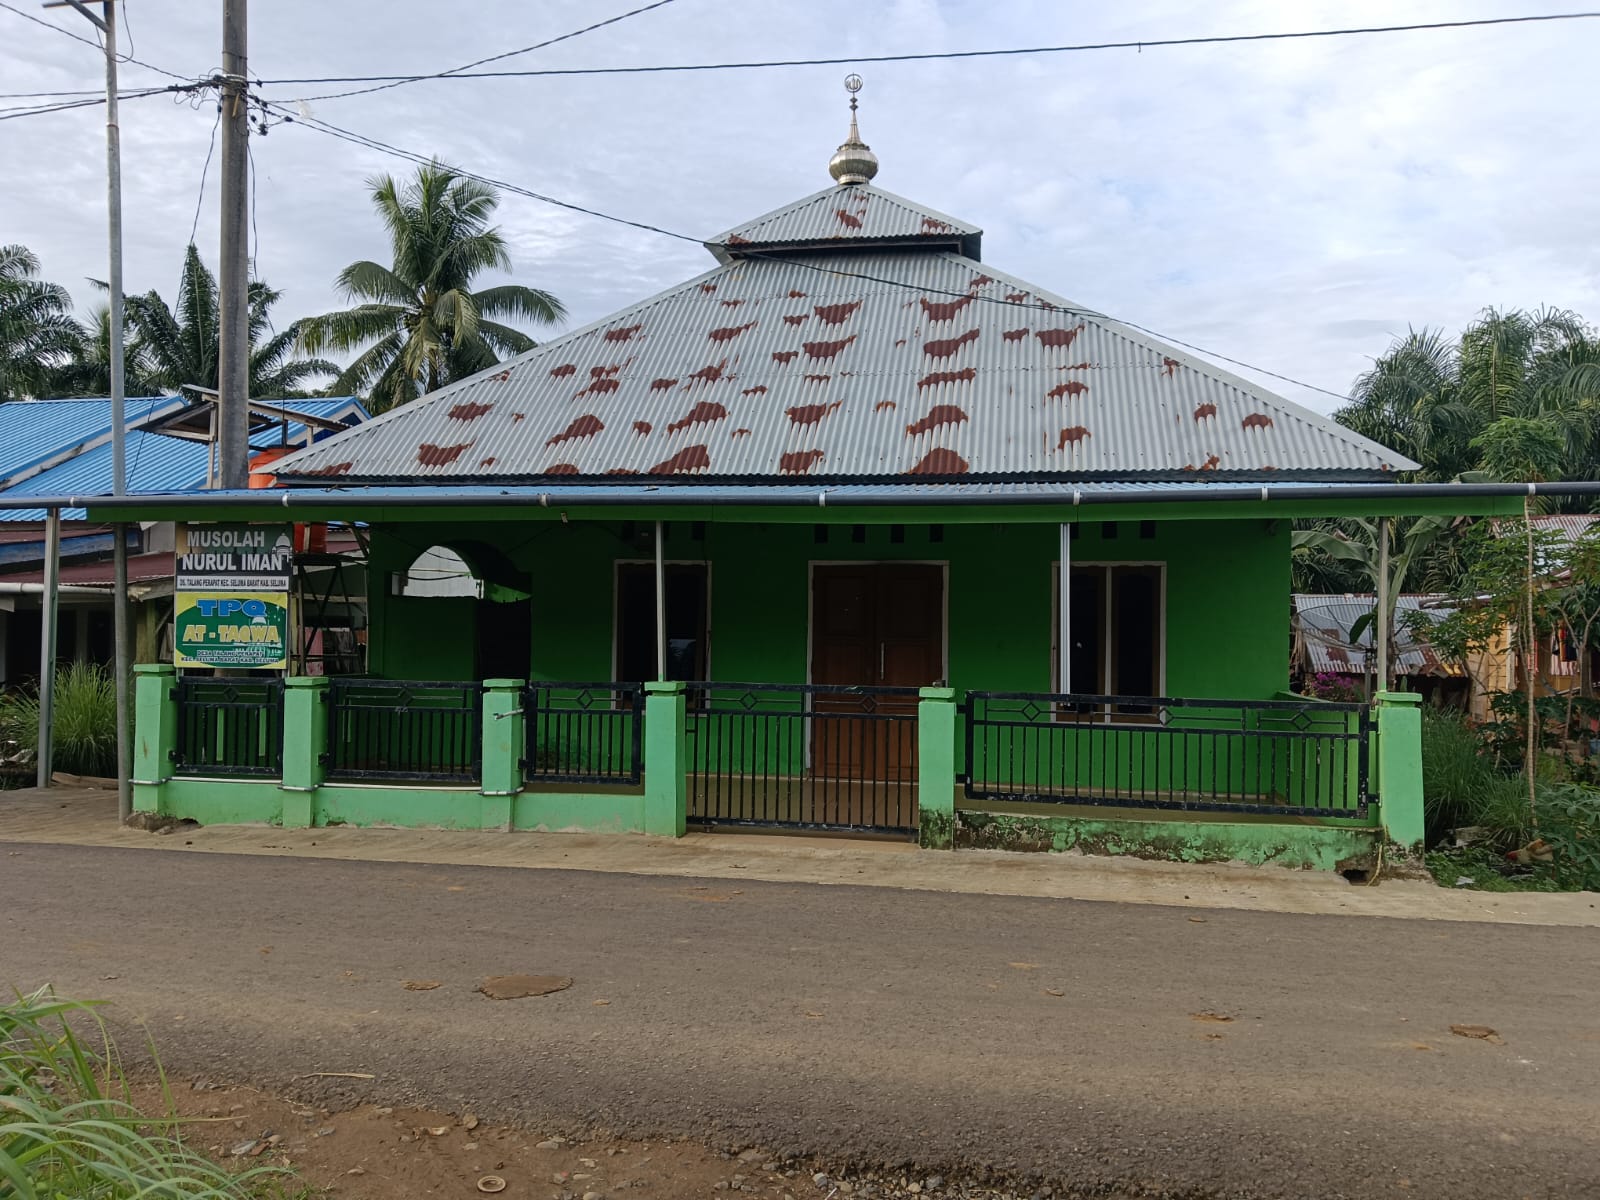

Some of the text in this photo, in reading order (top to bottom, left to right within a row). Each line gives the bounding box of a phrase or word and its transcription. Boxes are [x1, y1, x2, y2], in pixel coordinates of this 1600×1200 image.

[187, 531, 265, 547] MUSOLAH
[182, 554, 283, 570] NURUL IMAN
[196, 599, 268, 617] TPQ
[182, 625, 206, 642] AT
[217, 625, 280, 643] TAQWA
